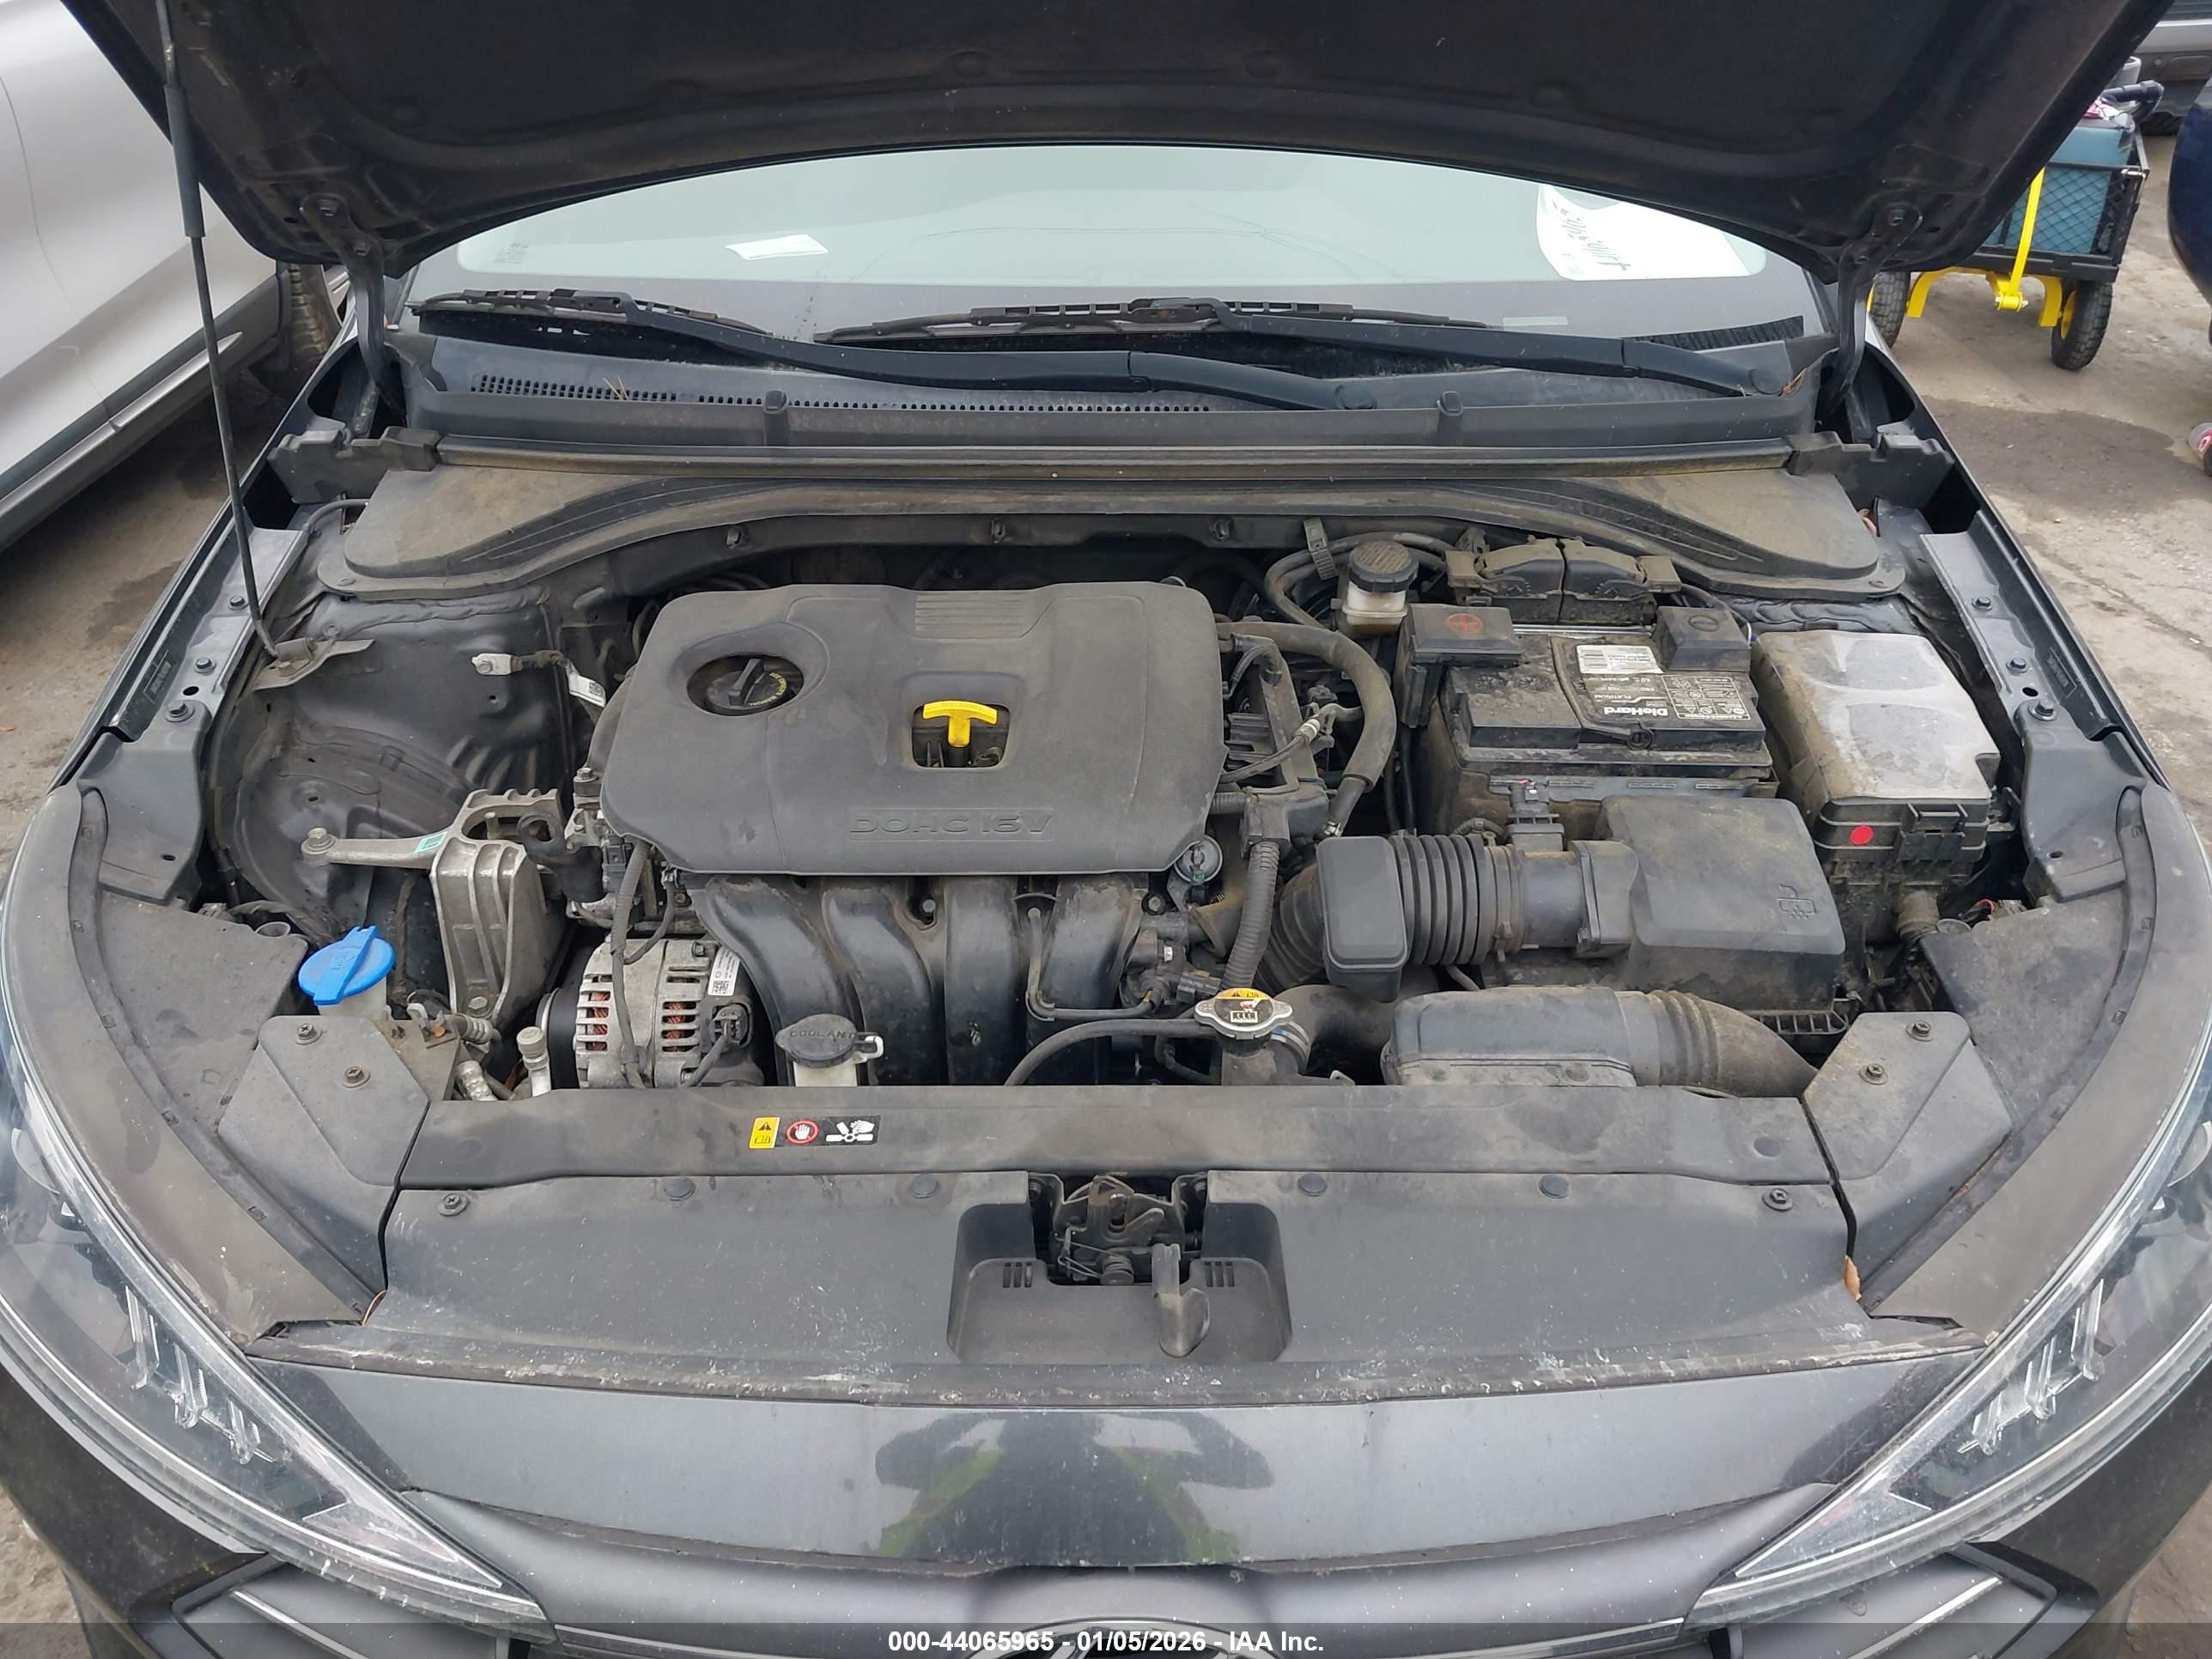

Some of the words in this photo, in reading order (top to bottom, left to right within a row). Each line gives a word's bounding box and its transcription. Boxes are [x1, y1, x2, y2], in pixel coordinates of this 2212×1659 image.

[1603, 707, 1668, 717] DieHard
[849, 814, 969, 834] DOHC
[982, 813, 1052, 834] 16V
[789, 1030, 857, 1039] COOLANT
